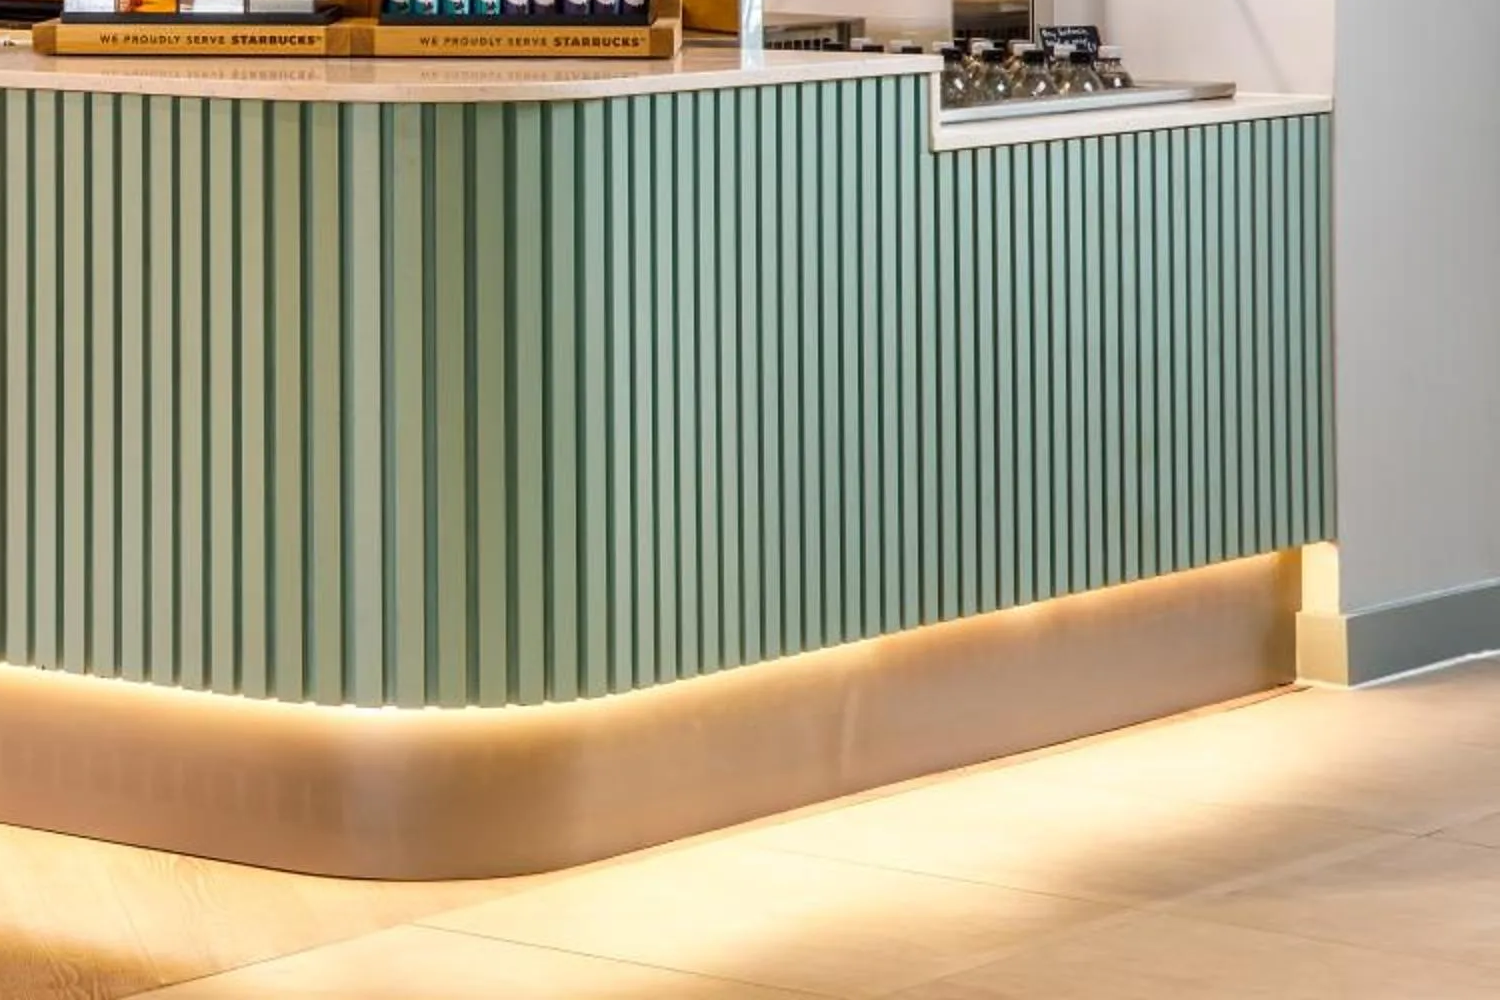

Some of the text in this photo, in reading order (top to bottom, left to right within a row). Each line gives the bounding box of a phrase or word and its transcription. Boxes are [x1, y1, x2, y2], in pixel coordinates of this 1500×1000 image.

[100, 35, 118, 45] WE
[123, 35, 180, 45] PROUDLY
[186, 35, 225, 45] SERVE
[443, 36, 502, 47] PROUDLY
[507, 36, 547, 47] SERVE
